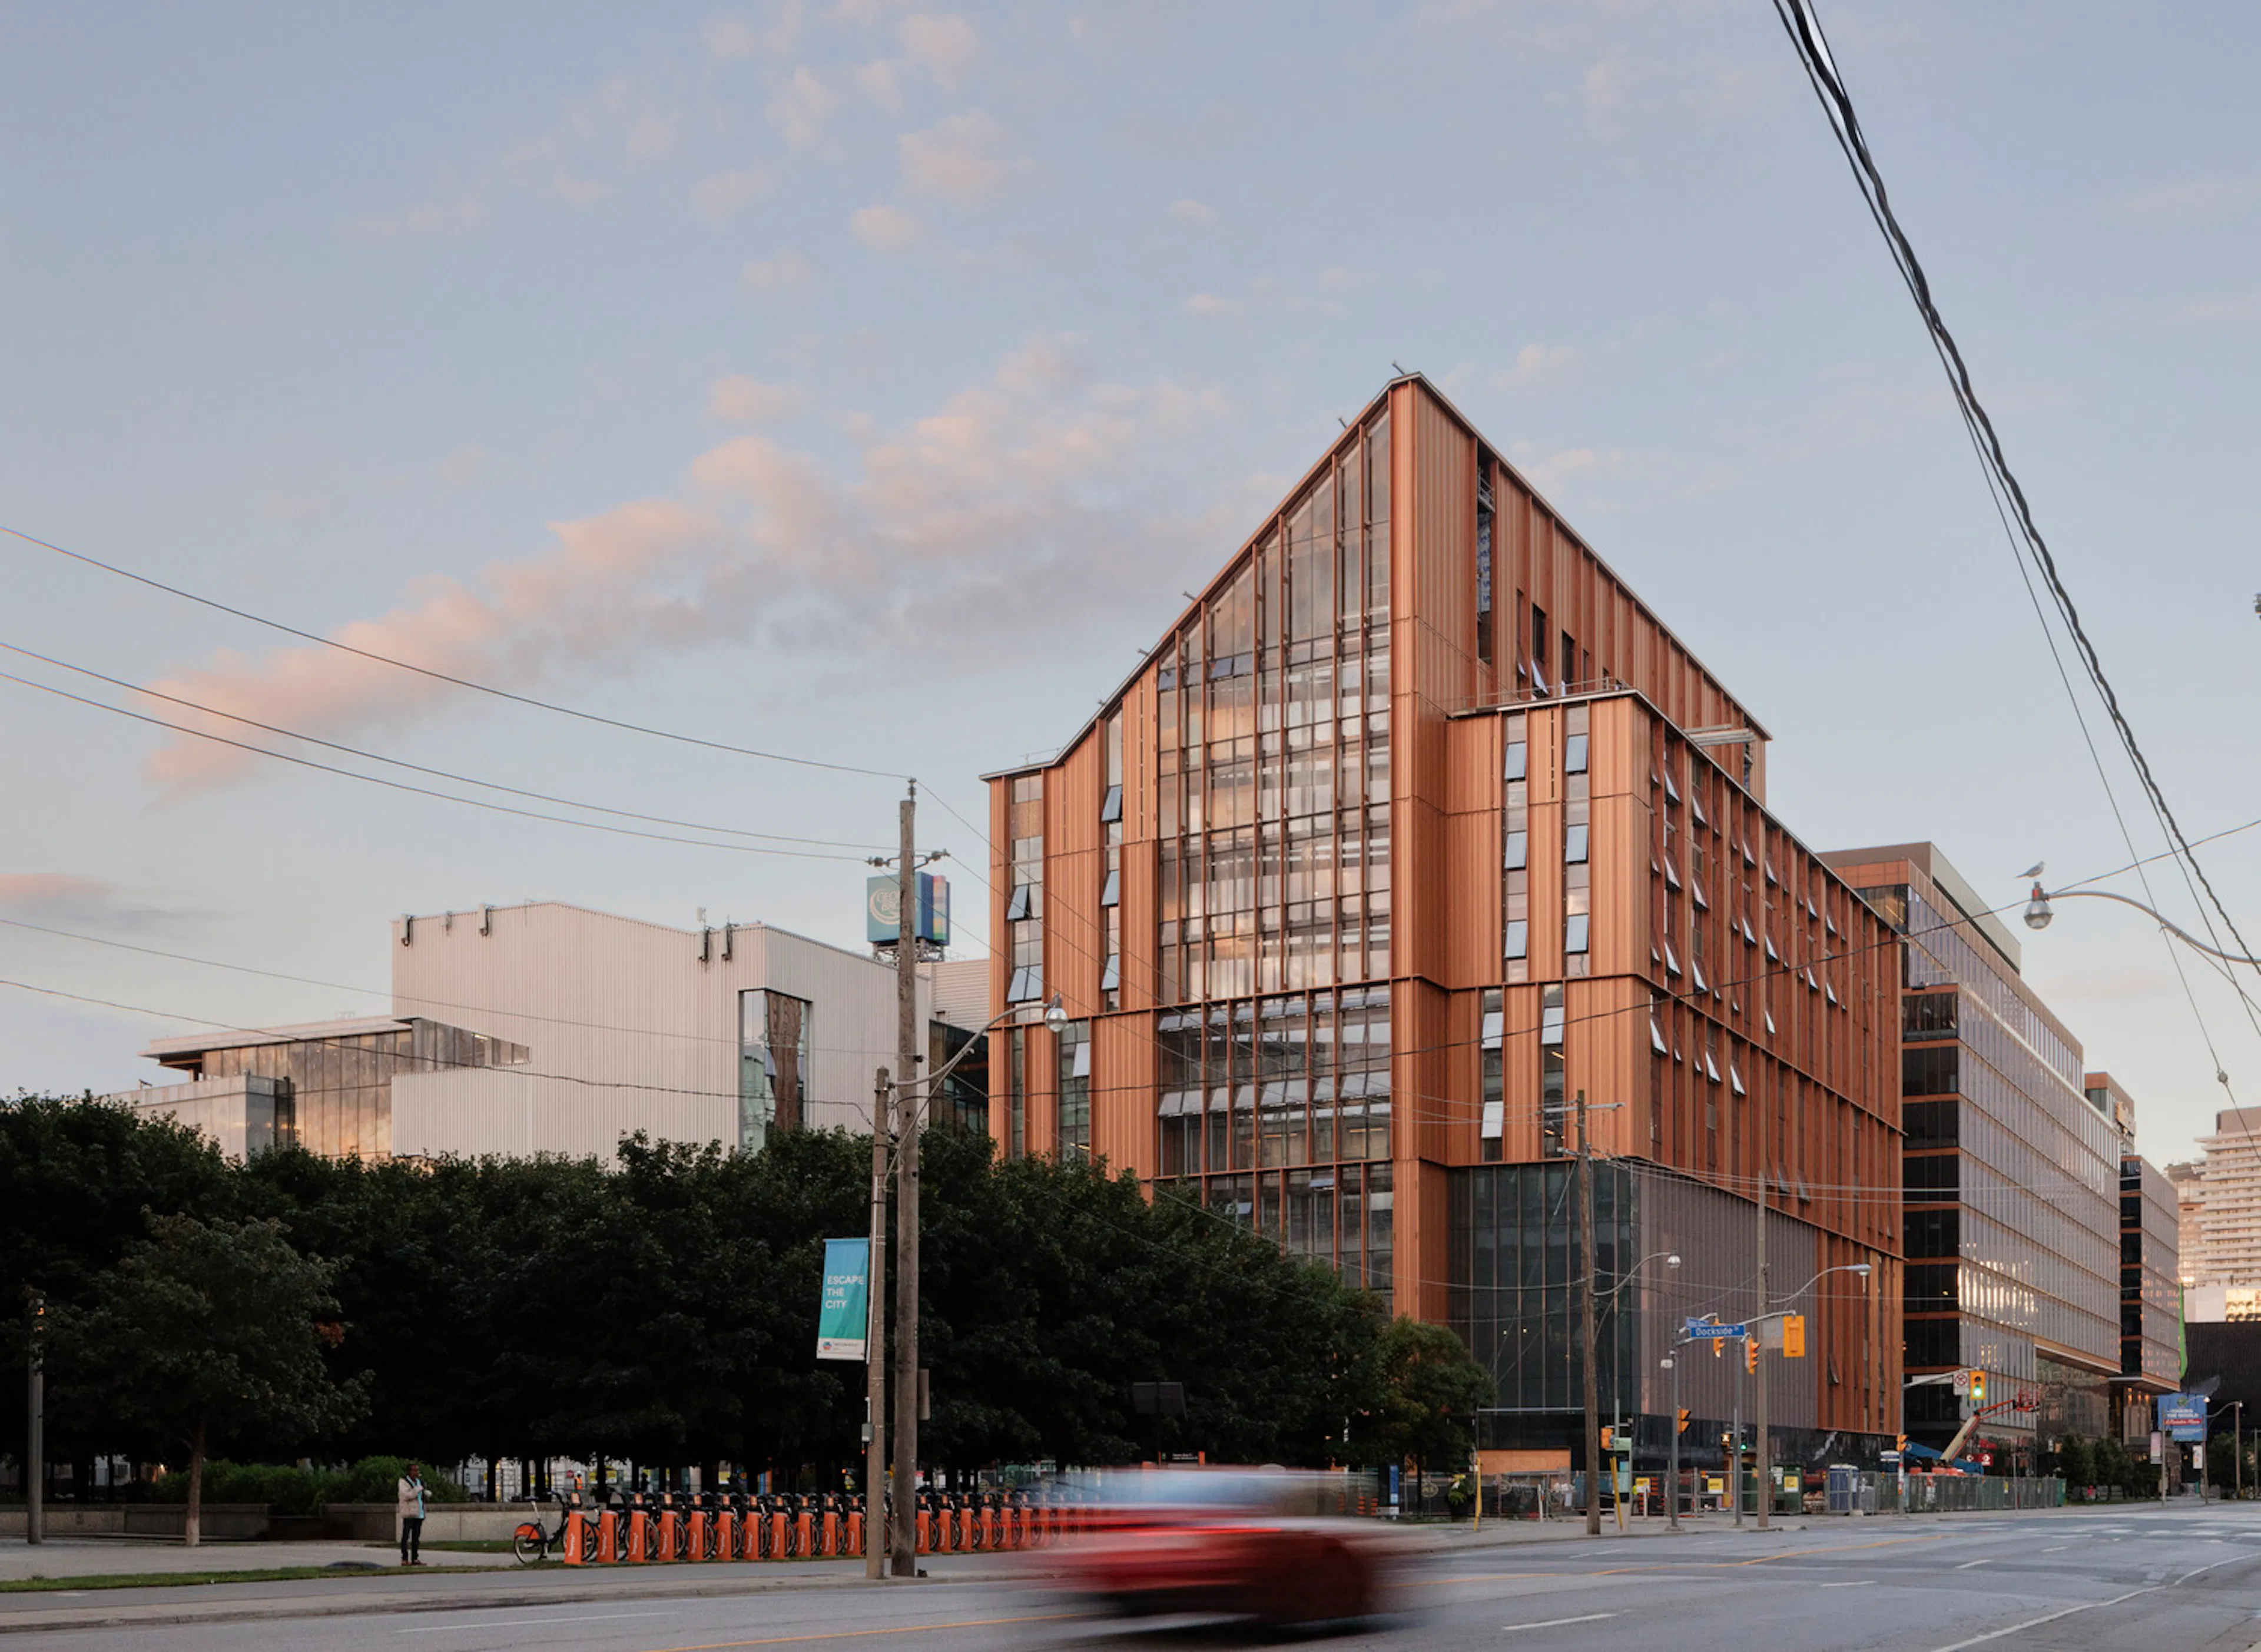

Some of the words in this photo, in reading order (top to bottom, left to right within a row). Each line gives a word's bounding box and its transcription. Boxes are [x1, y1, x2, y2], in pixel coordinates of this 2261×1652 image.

[827, 1275, 864, 1285] ESCAPE
[826, 1288, 844, 1297] THE
[825, 1299, 848, 1309] CITY
[1695, 1327, 1733, 1336] Dockside
